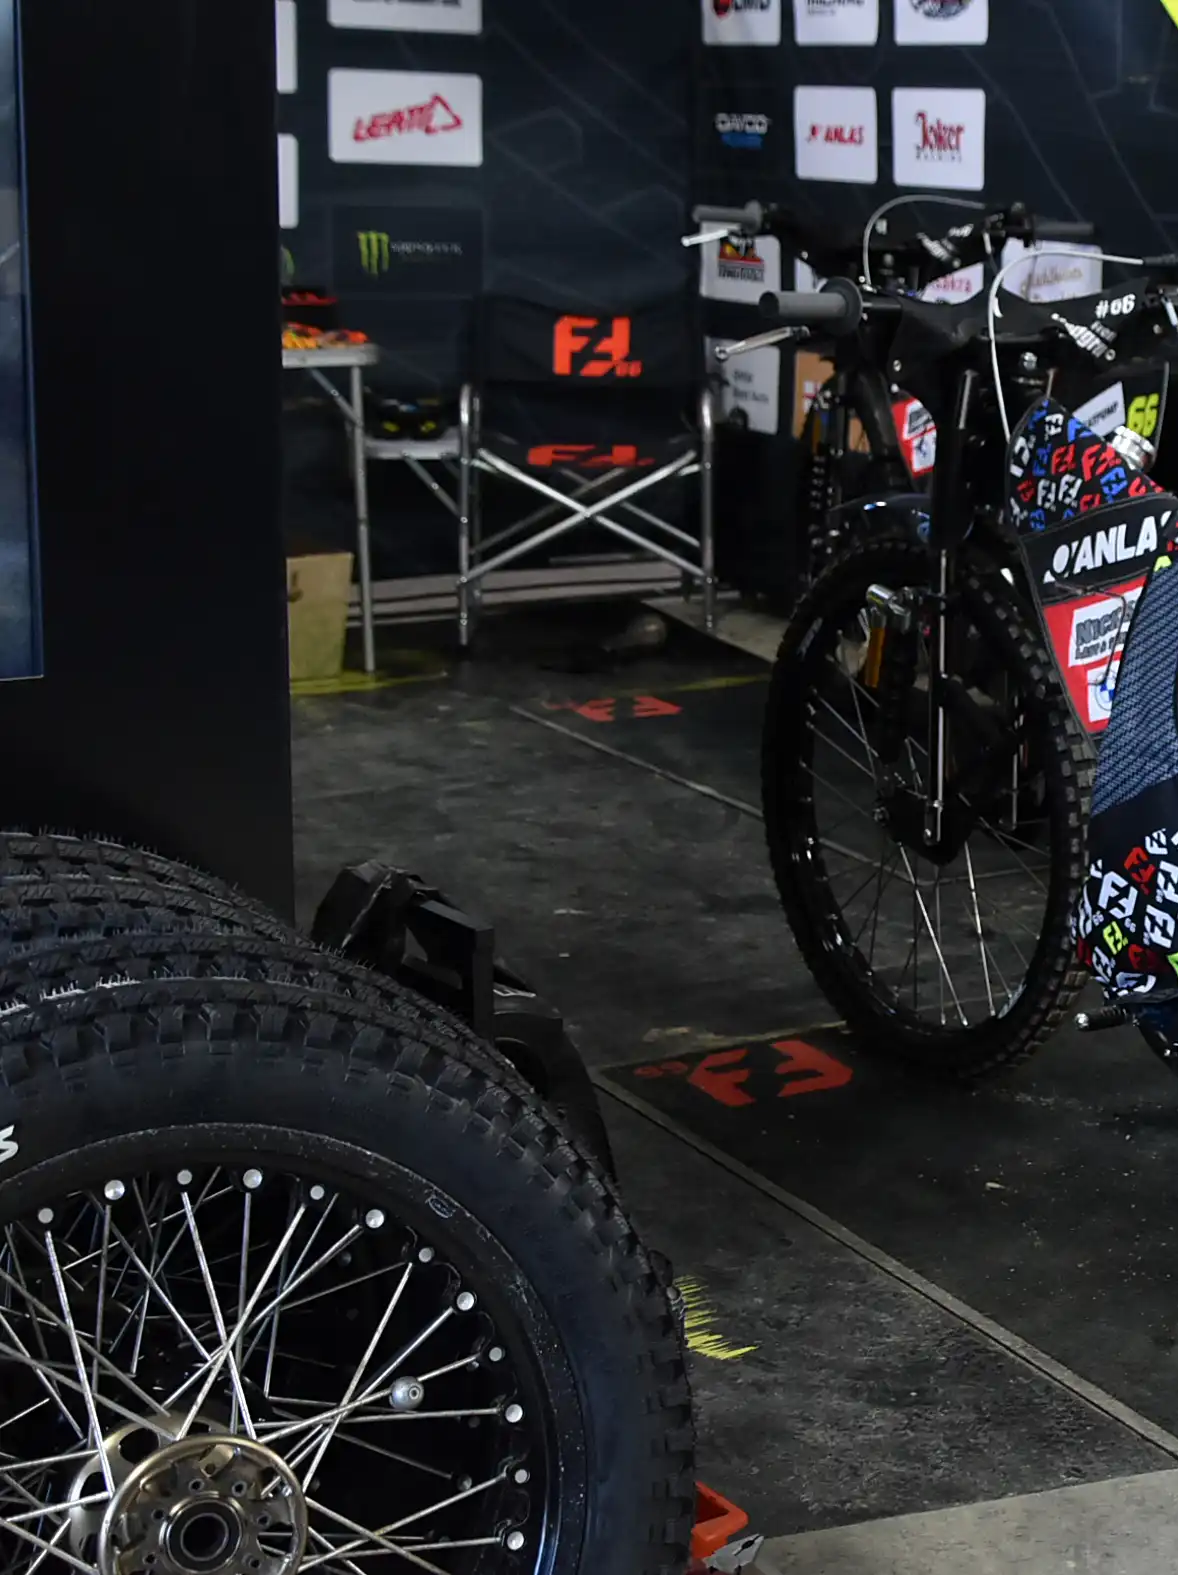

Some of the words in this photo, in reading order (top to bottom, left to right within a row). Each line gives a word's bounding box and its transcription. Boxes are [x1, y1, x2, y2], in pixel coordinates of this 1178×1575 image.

[915, 110, 965, 152] Joker
[1128, 393, 1160, 438] 66
[1073, 511, 1172, 573] ANLA
